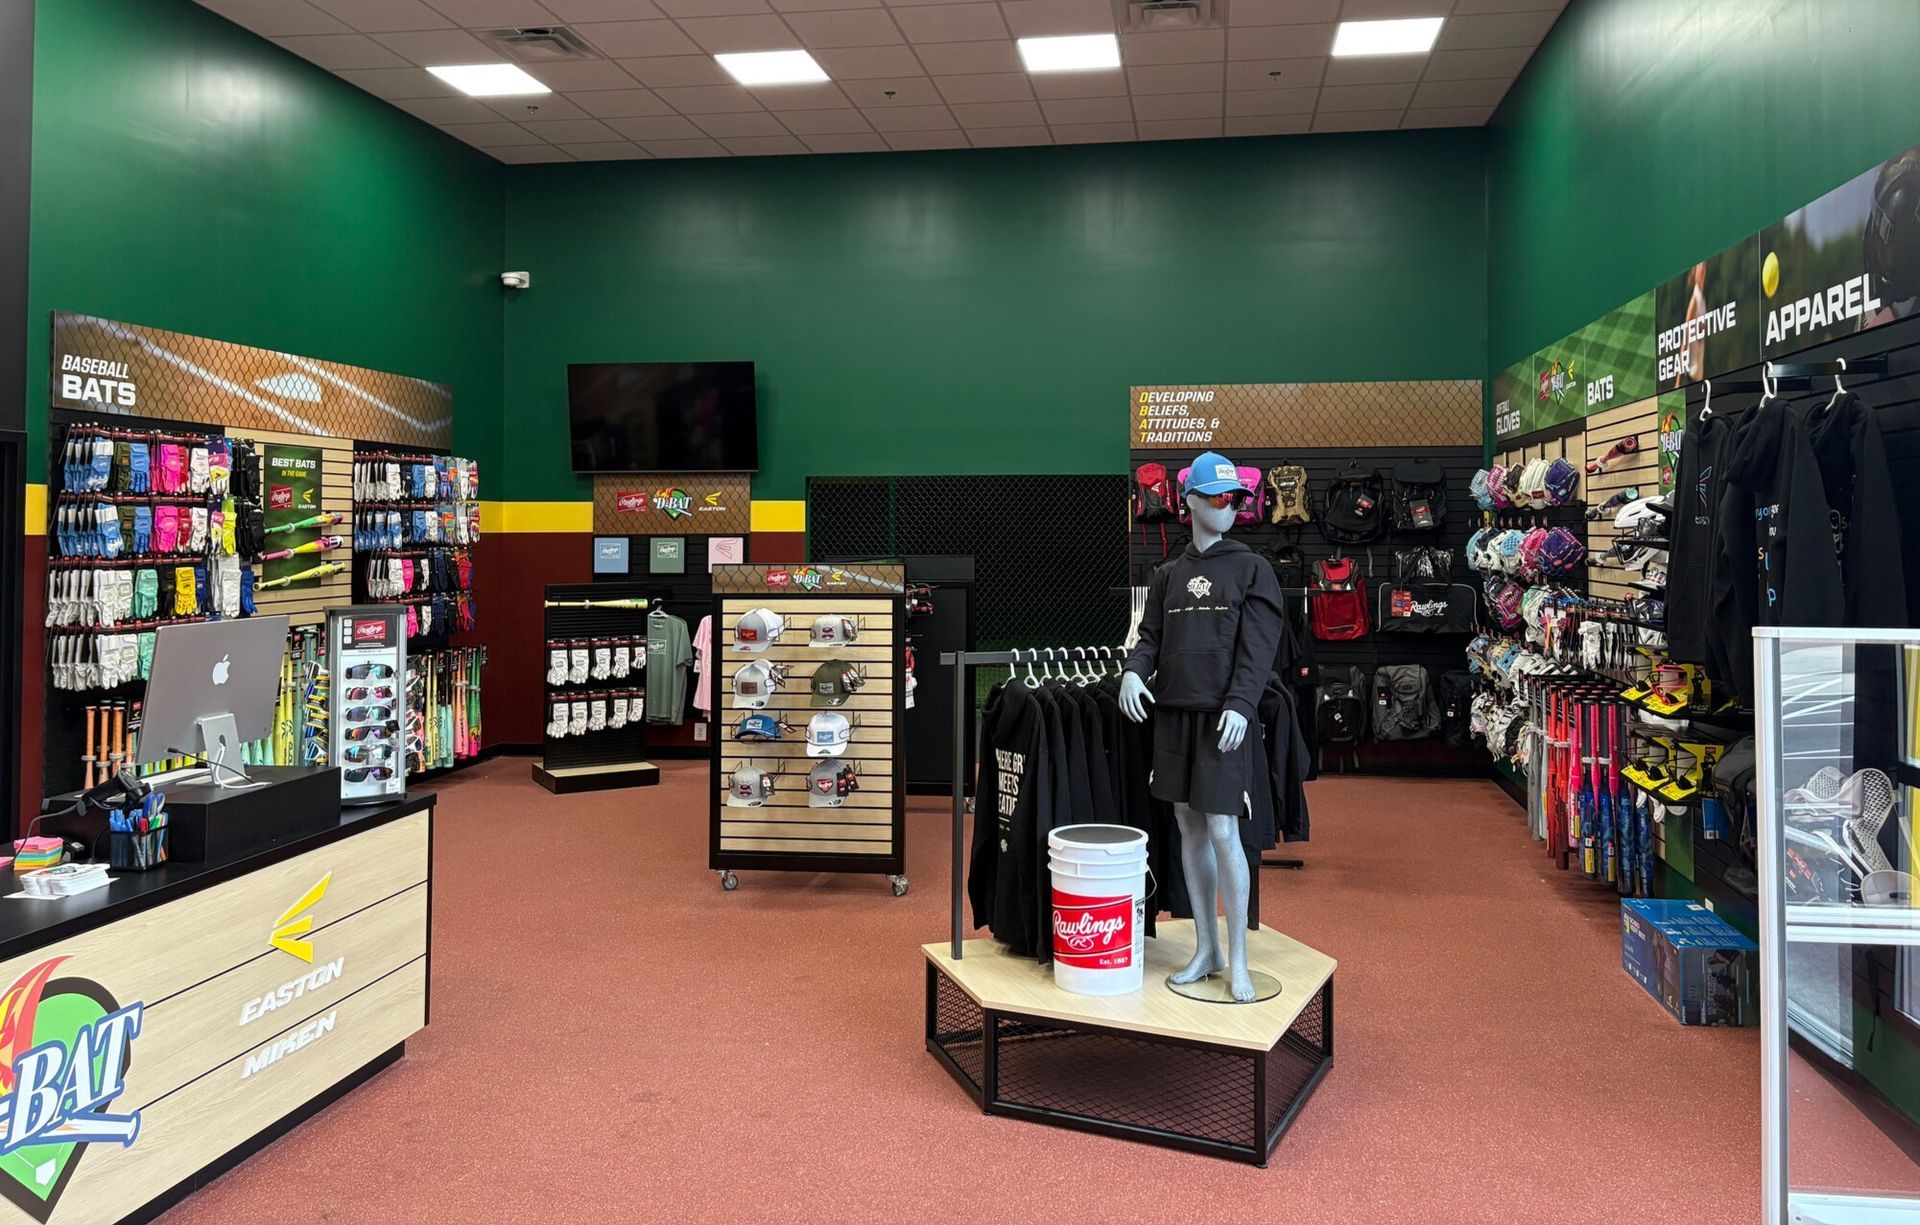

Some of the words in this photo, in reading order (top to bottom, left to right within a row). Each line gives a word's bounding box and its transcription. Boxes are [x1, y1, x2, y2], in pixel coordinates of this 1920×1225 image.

[1765, 273, 1881, 346] APPAREL
[1658, 301, 1736, 355] PROTECTIVE
[61, 354, 129, 379] BASEBALL
[1658, 349, 1690, 382] GEAR
[62, 374, 136, 406] BATS
[1139, 391, 1214, 403] DEVELOPING
[1587, 375, 1614, 406] BATS
[1139, 405, 1190, 417] BELIEFS,
[1139, 418, 1207, 430] ATTITUDES,
[1211, 418, 1220, 429] &
[1496, 410, 1520, 436] GLOVES
[1140, 431, 1213, 443] TRADITIONS
[271, 457, 294, 467] BEST
[295, 458, 316, 469] BATS
[1410, 599, 1448, 614] Rawlings
[1052, 910, 1125, 945] Rawlings
[239, 957, 344, 1026] EASTON
[241, 1010, 337, 1080] MIKEN
